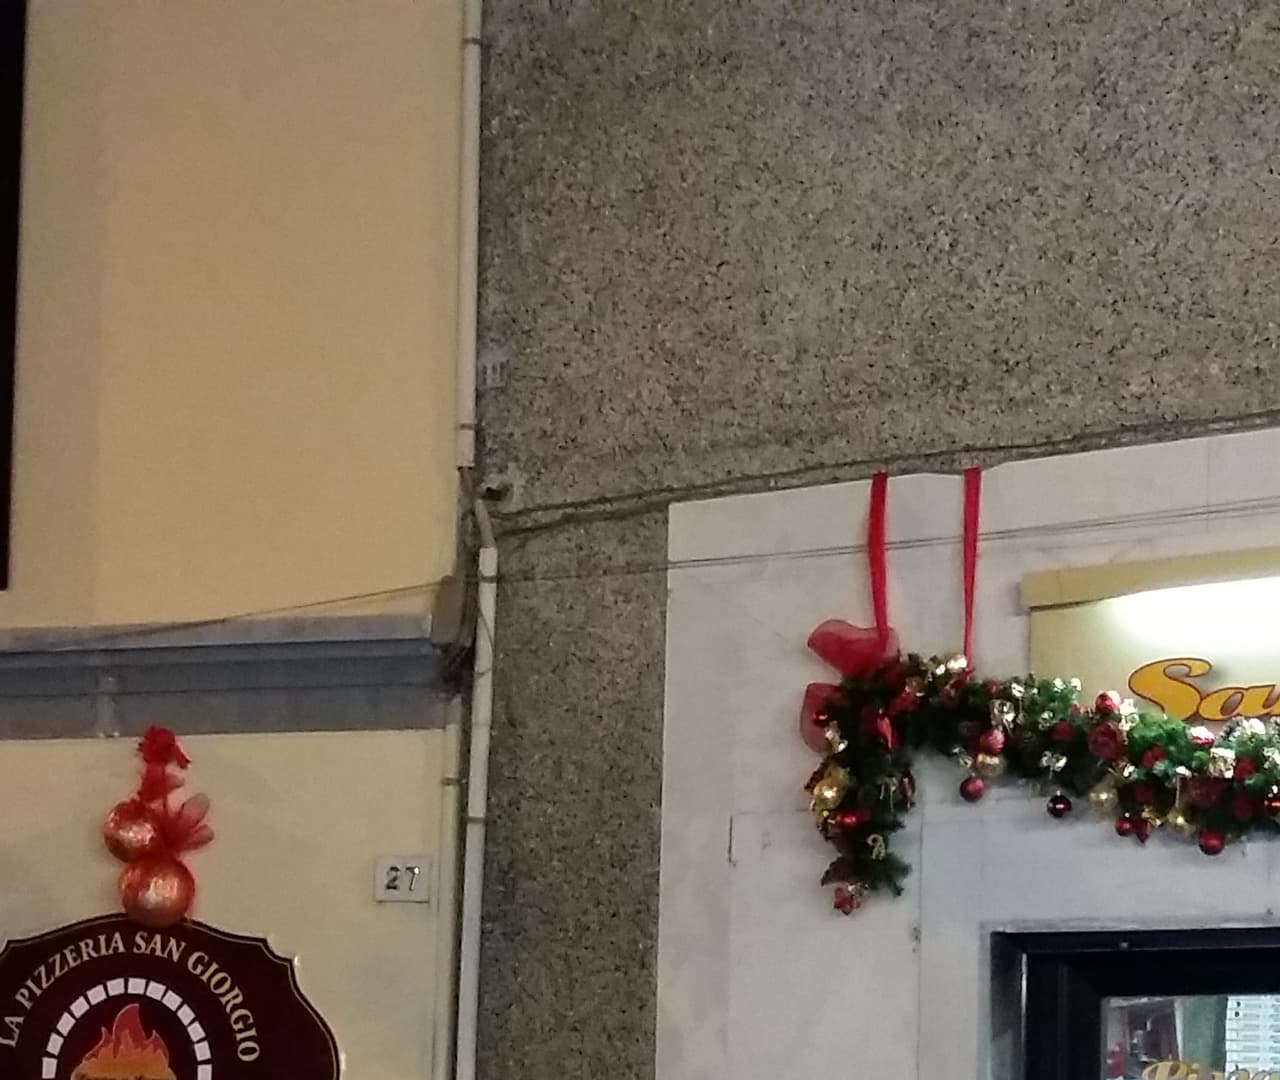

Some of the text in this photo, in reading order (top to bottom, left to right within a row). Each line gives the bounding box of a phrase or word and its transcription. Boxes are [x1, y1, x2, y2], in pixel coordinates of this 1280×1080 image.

[385, 865, 421, 892] 27
[15, 931, 126, 1010] PIZZERIA
[132, 931, 187, 963] SAN
[187, 951, 261, 1062] GIORGIO
